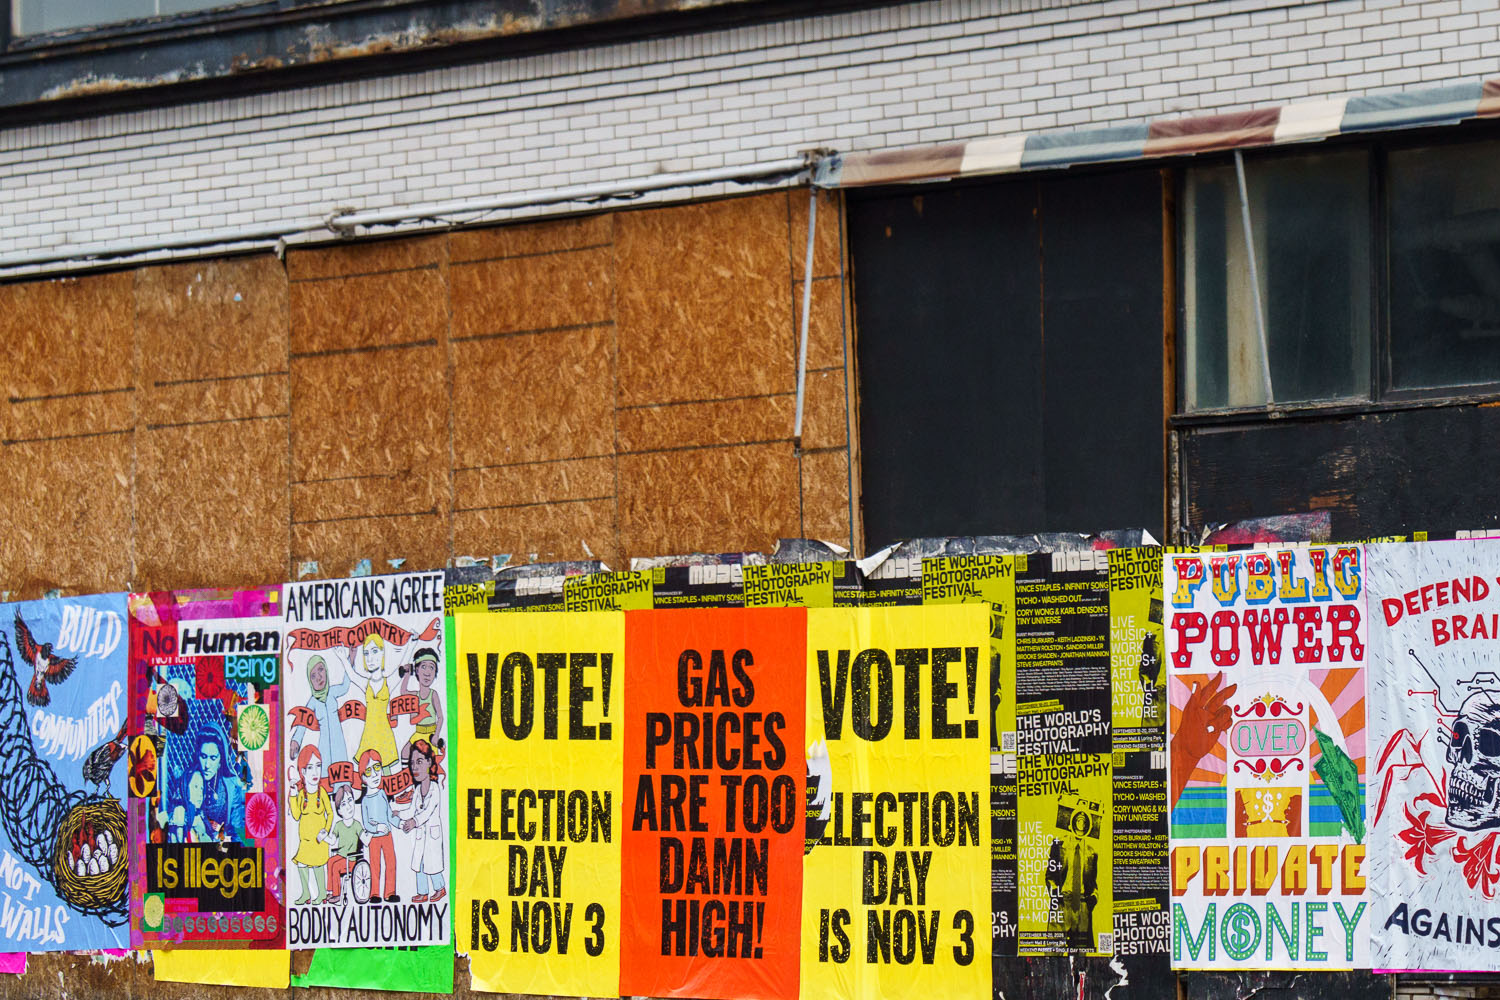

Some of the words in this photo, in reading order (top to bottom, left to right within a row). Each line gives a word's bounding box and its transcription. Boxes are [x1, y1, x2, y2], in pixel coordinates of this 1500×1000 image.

[923, 558, 945, 573] THE
[950, 555, 1004, 569] WORLD'S
[1108, 549, 1133, 563] THE
[566, 576, 587, 588] THE
[590, 570, 642, 585] WORLD'S
[744, 565, 768, 580] THE
[772, 562, 824, 577] WORLD'S
[745, 570, 831, 593] PHOTOGRAPHY
[923, 563, 1013, 587] PHOTOGRAPHY
[1171, 547, 1362, 609] PUBLIC
[286, 579, 385, 622] AMERICANS
[388, 575, 442, 616] AGREE
[566, 578, 650, 599] PHOTOGRAPHY
[745, 590, 804, 606] FESTIVAL.
[924, 582, 983, 600] FESTIVAL.
[1016, 585, 1034, 593] VINCE
[1035, 583, 1061, 592] STAPLES
[1064, 582, 1090, 591] INFINITY
[1090, 581, 1109, 590] SONG
[1016, 596, 1037, 605] TYCHO
[1041, 595, 1068, 604] WASHED
[1068, 594, 1083, 603] OUT
[1016, 608, 1034, 617] CORY
[1034, 607, 1055, 616] WONG
[1060, 606, 1077, 615] KARL
[1077, 605, 1109, 614] DENSON'S
[1381, 576, 1490, 627] DEFEND
[56, 605, 122, 660] BUILD
[1016, 617, 1031, 625] TINY
[1031, 616, 1062, 624] UNIVERSE
[1111, 615, 1136, 628] LIVE
[143, 629, 177, 655] No
[181, 628, 280, 654] Human
[300, 633, 321, 648] FOR
[323, 630, 343, 647] THE
[347, 620, 405, 648] COUNTRY
[1170, 604, 1365, 668] POWER
[1111, 641, 1144, 654] WORK
[225, 654, 277, 683] Being
[677, 648, 755, 708] GAS
[1112, 668, 1133, 680] ART
[466, 652, 614, 741] VOTE!
[816, 647, 979, 742] VOTE!
[1112, 680, 1158, 693] INSTALL
[299, 709, 315, 726] TO
[344, 703, 361, 718] BE
[391, 697, 417, 715] FREE
[1112, 693, 1153, 706] ATIONS
[32, 680, 123, 762] COMMUNITIES
[1017, 716, 1041, 729] THE
[1045, 709, 1101, 726] WORLD'S
[645, 711, 787, 770] PRICES
[1017, 722, 1110, 744] PHOTOGRAPHY
[1237, 723, 1300, 752] OVER
[1017, 740, 1080, 756] FESTIVAL.
[1017, 756, 1042, 769] THE
[1045, 753, 1101, 767] WORLD'S
[1018, 762, 1110, 783] PHOTOGRAPHY
[330, 765, 350, 781] WE
[382, 773, 410, 794] NEED
[1019, 781, 1079, 797] FESTIVAL.
[467, 787, 612, 843] ELECTION
[631, 774, 714, 833] ARE
[719, 774, 796, 834] TOO
[1018, 821, 1042, 834] LIVE
[1019, 847, 1051, 859] WORK
[0, 852, 42, 900] NOT
[157, 847, 179, 888] Is
[184, 846, 263, 898] Illegal
[508, 845, 567, 899] DAY
[659, 837, 769, 896] DAMN
[862, 851, 933, 906] DAY
[1019, 872, 1041, 884] ART
[1171, 844, 1366, 896] PRIVATE
[1019, 885, 1064, 898] INSTALL
[1019, 898, 1059, 911] ATIONS
[0, 892, 70, 944] WALLS
[289, 905, 347, 944] BODILY
[347, 903, 448, 943] AUTONOMY
[471, 898, 499, 951] IS
[510, 901, 574, 956] NOV
[585, 903, 605, 957] 3
[661, 899, 765, 960] HIGH!
[1112, 913, 1137, 928] THE
[818, 908, 851, 963] IS
[867, 909, 941, 966] NOV
[953, 909, 975, 967] 3
[1172, 902, 1368, 962] MONEY
